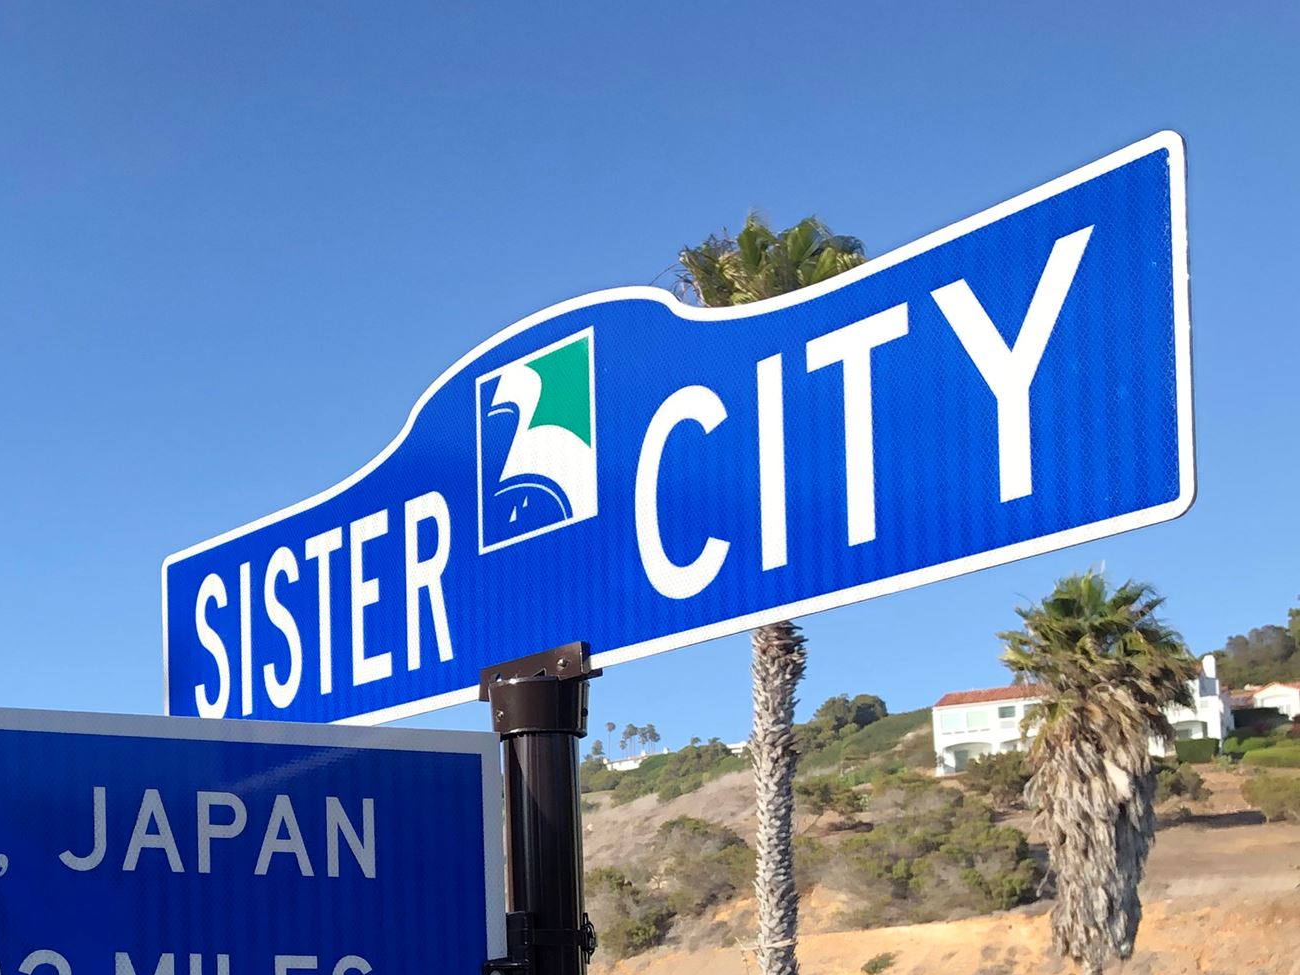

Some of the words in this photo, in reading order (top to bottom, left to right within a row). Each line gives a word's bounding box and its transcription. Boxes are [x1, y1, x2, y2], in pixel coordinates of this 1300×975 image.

[194, 490, 454, 719] SISTER
[635, 224, 1095, 599] CITY
[57, 785, 377, 879] JAPAN
